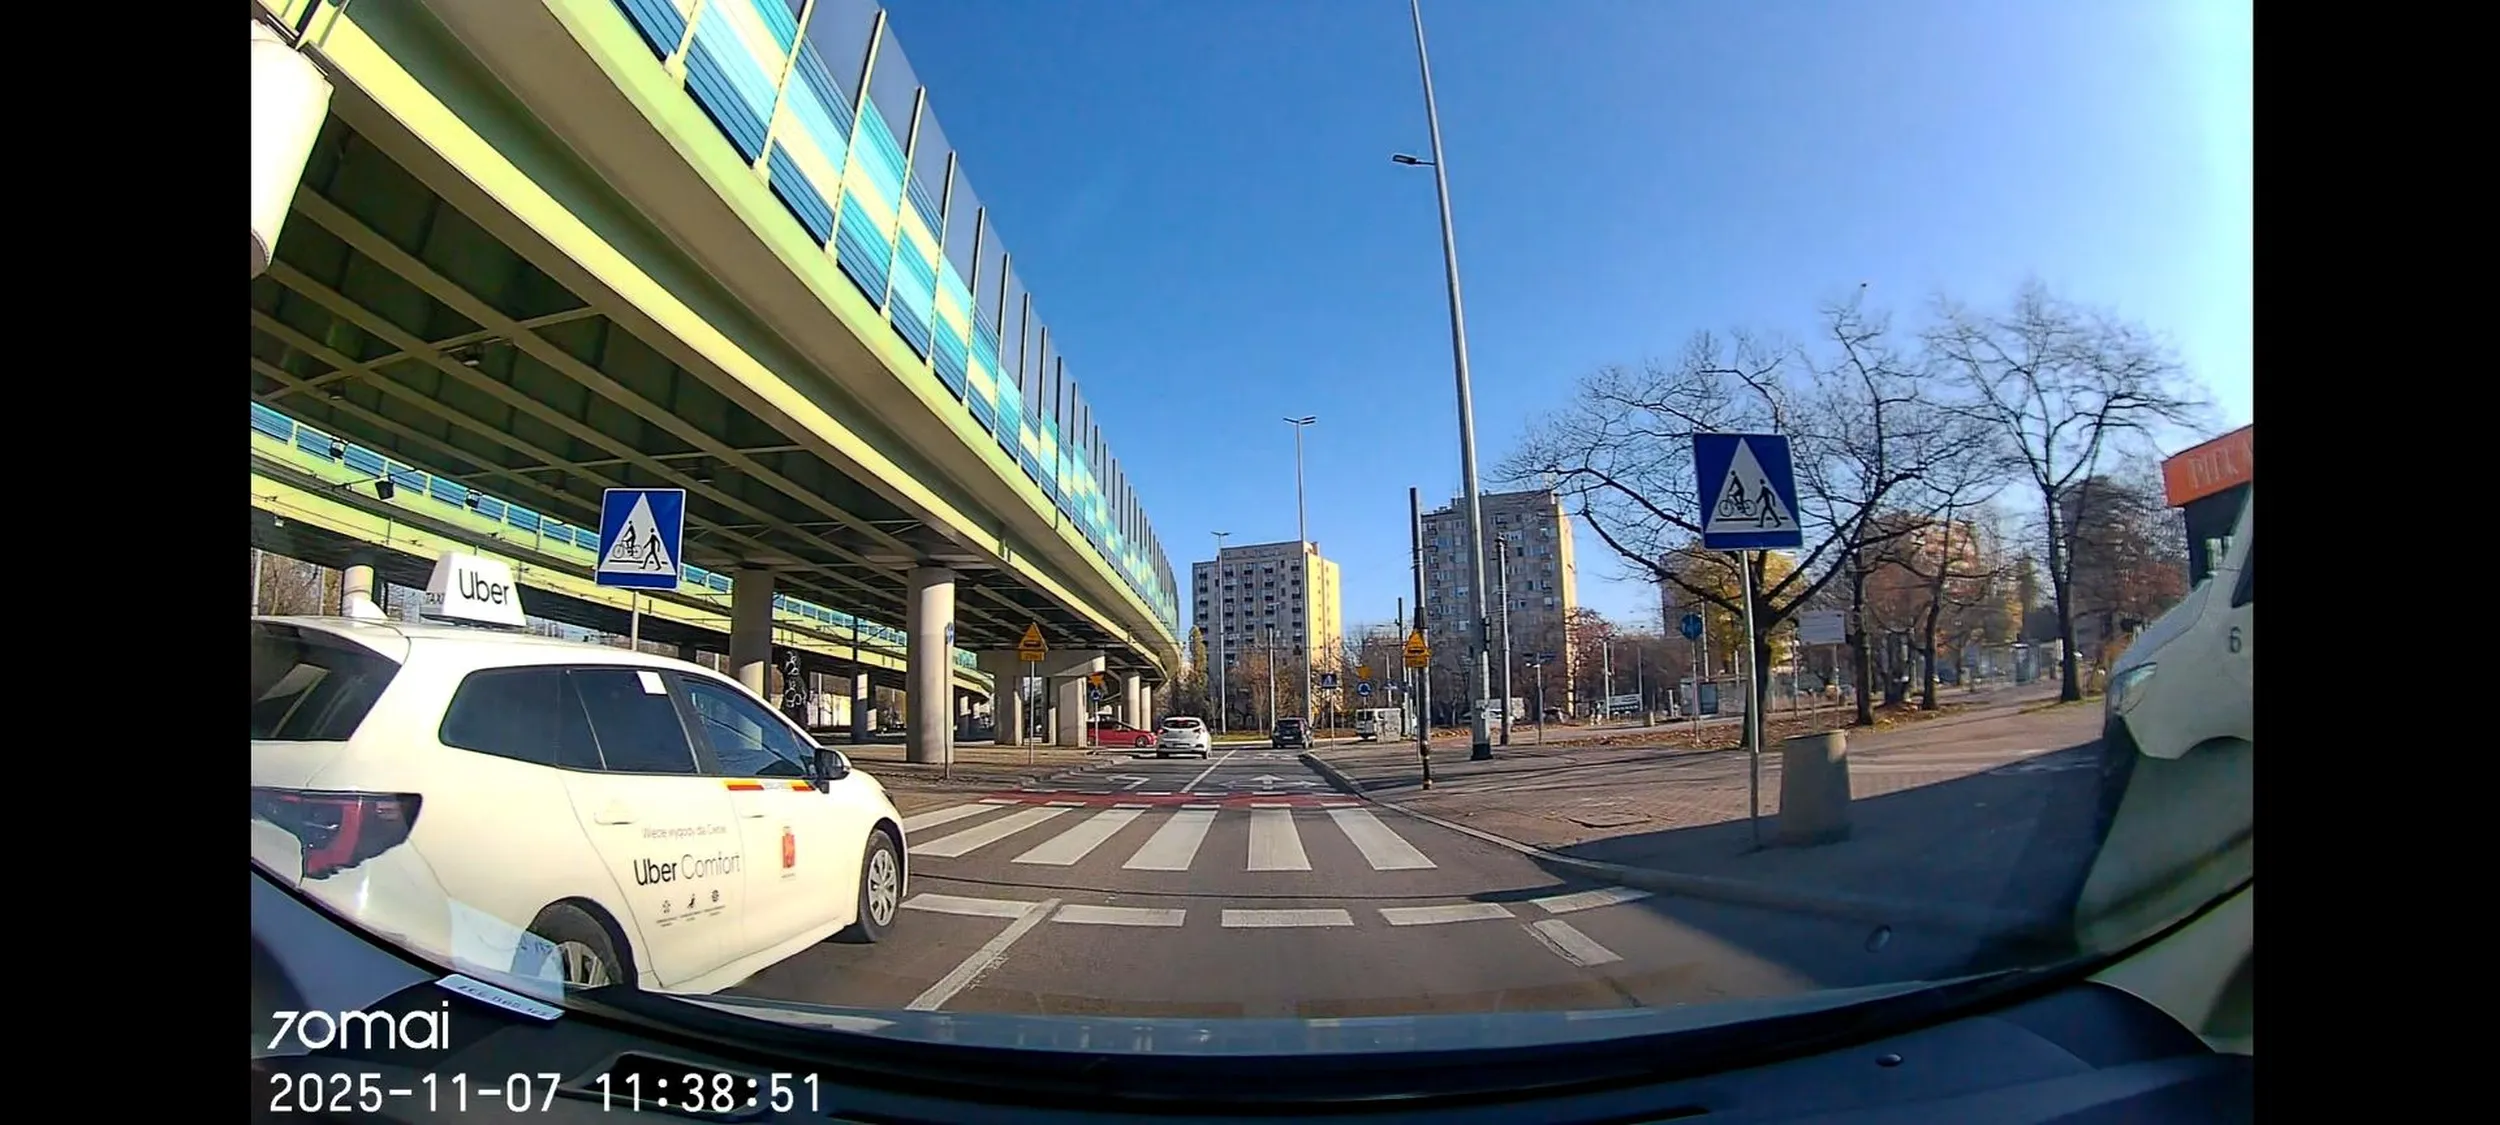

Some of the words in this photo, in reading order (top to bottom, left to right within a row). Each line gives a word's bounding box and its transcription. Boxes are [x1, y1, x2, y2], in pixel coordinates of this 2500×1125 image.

[458, 567, 510, 605] Uber
[2229, 625, 2242, 654] 6
[634, 858, 677, 886] Uber
[681, 851, 741, 880] Comfort
